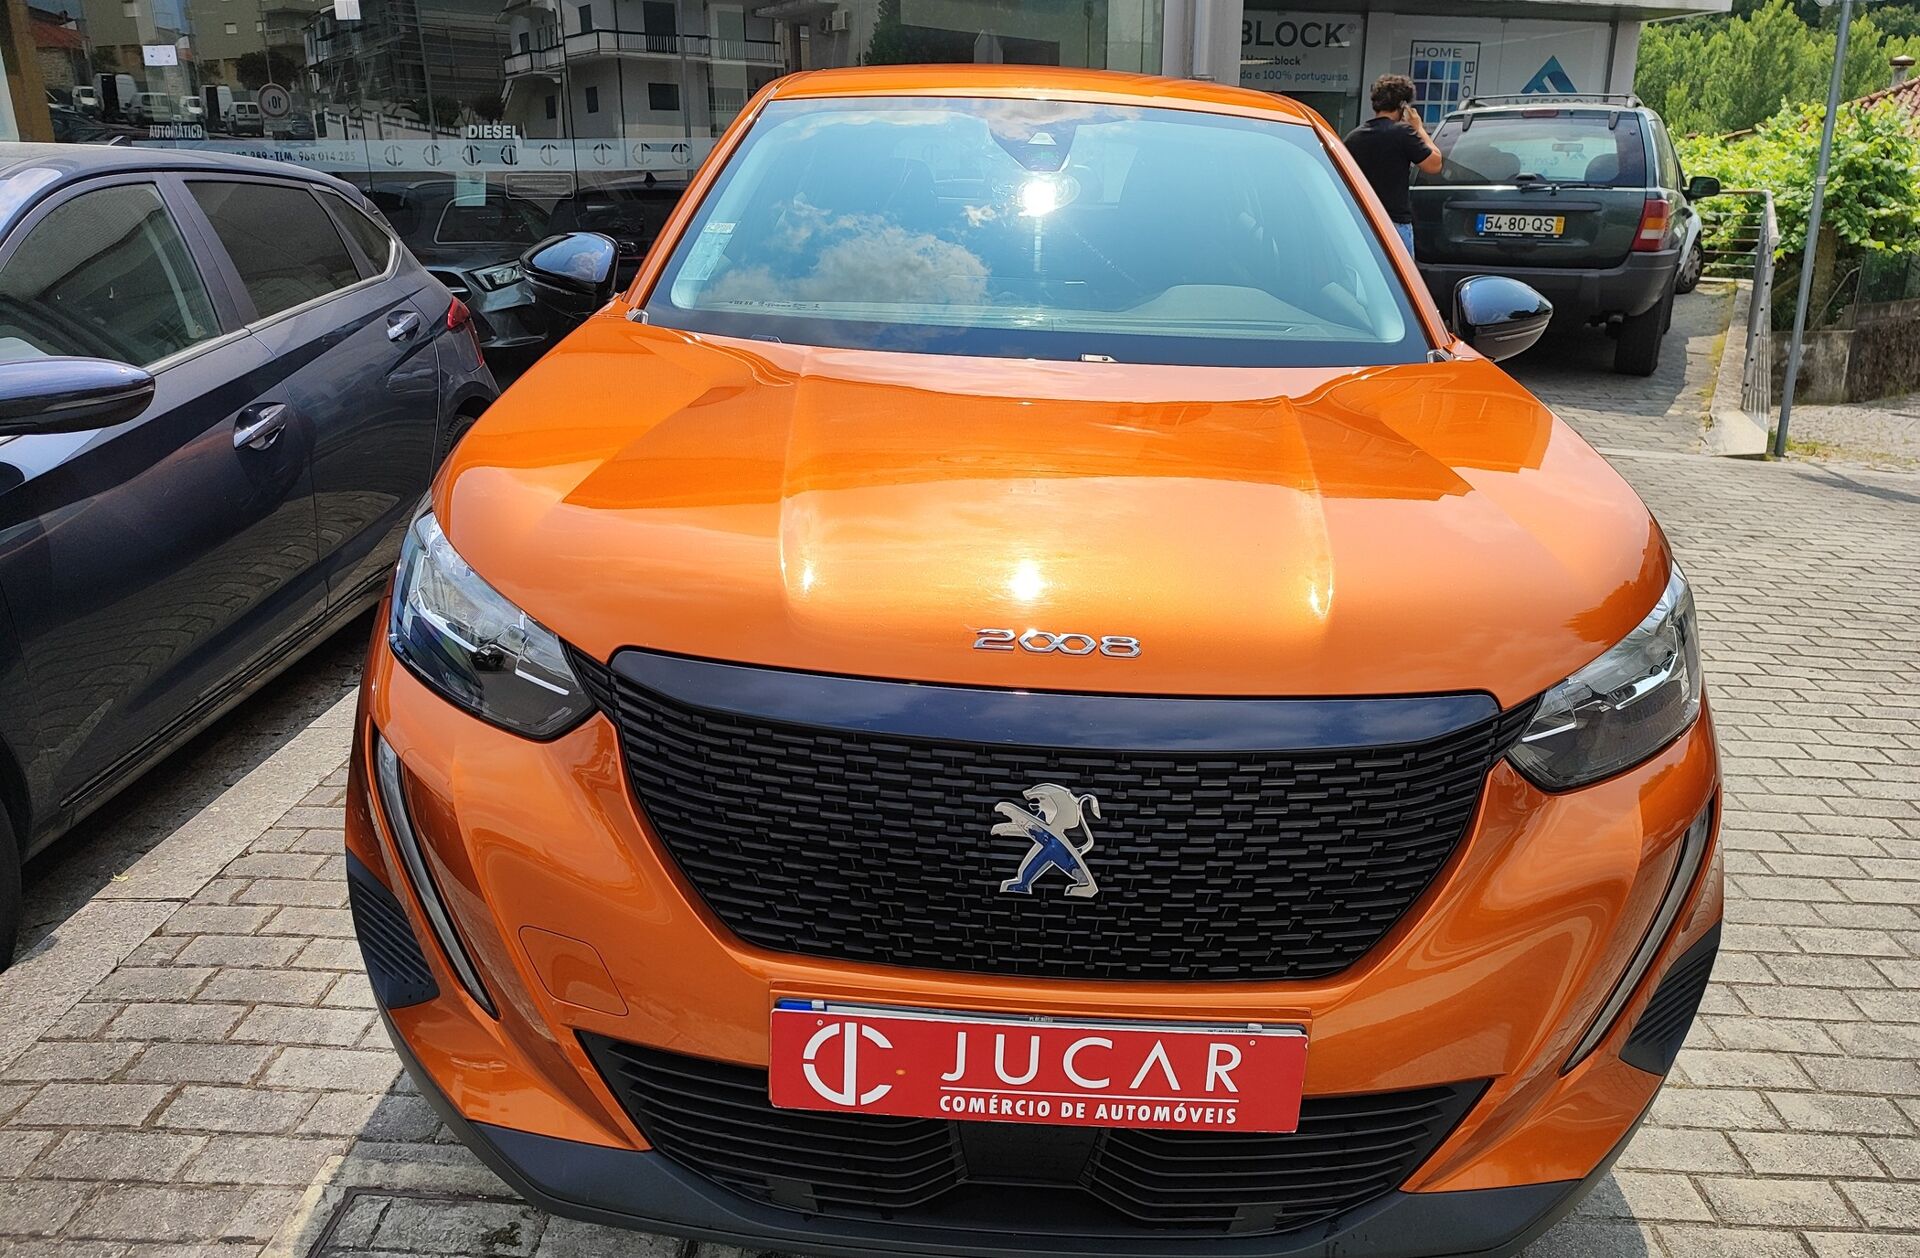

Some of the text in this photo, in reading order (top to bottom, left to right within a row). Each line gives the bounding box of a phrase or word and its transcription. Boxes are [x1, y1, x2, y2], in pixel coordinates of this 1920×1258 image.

[1415, 47, 1462, 59] HOME
[468, 124, 519, 139] DIESEL
[973, 629, 1142, 657] 2008
[940, 1031, 1242, 1093] JUCAR
[940, 1094, 1236, 1125] COMÉRCIO DE AUTOMÓVEIS
